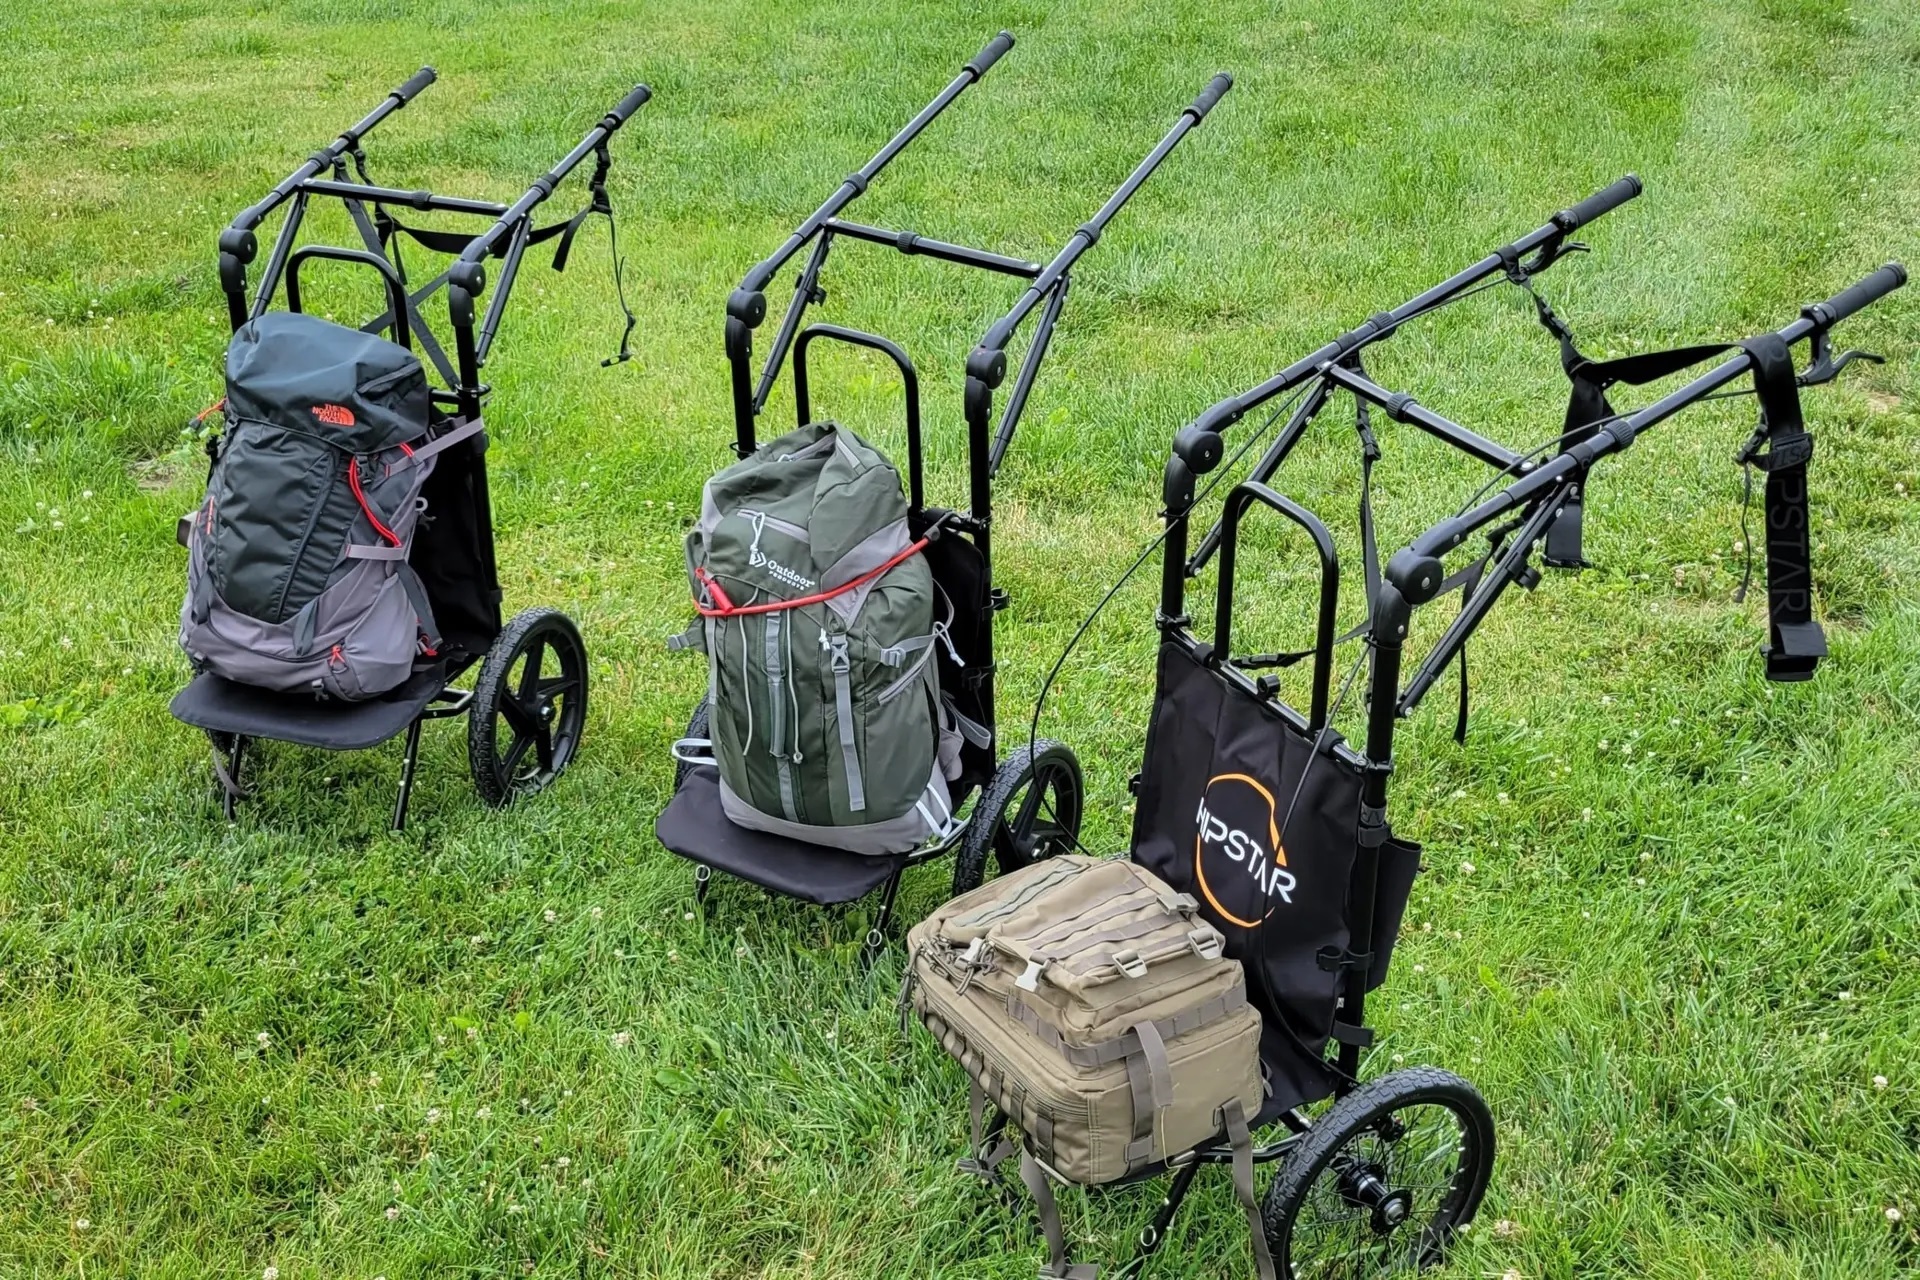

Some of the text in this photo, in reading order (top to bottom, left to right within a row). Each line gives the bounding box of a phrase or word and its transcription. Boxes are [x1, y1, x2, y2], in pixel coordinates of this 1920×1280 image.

[312, 406, 340, 419] NORTH
[324, 403, 340, 411] THE
[319, 415, 342, 424] FACE
[767, 560, 811, 588] Outdoor
